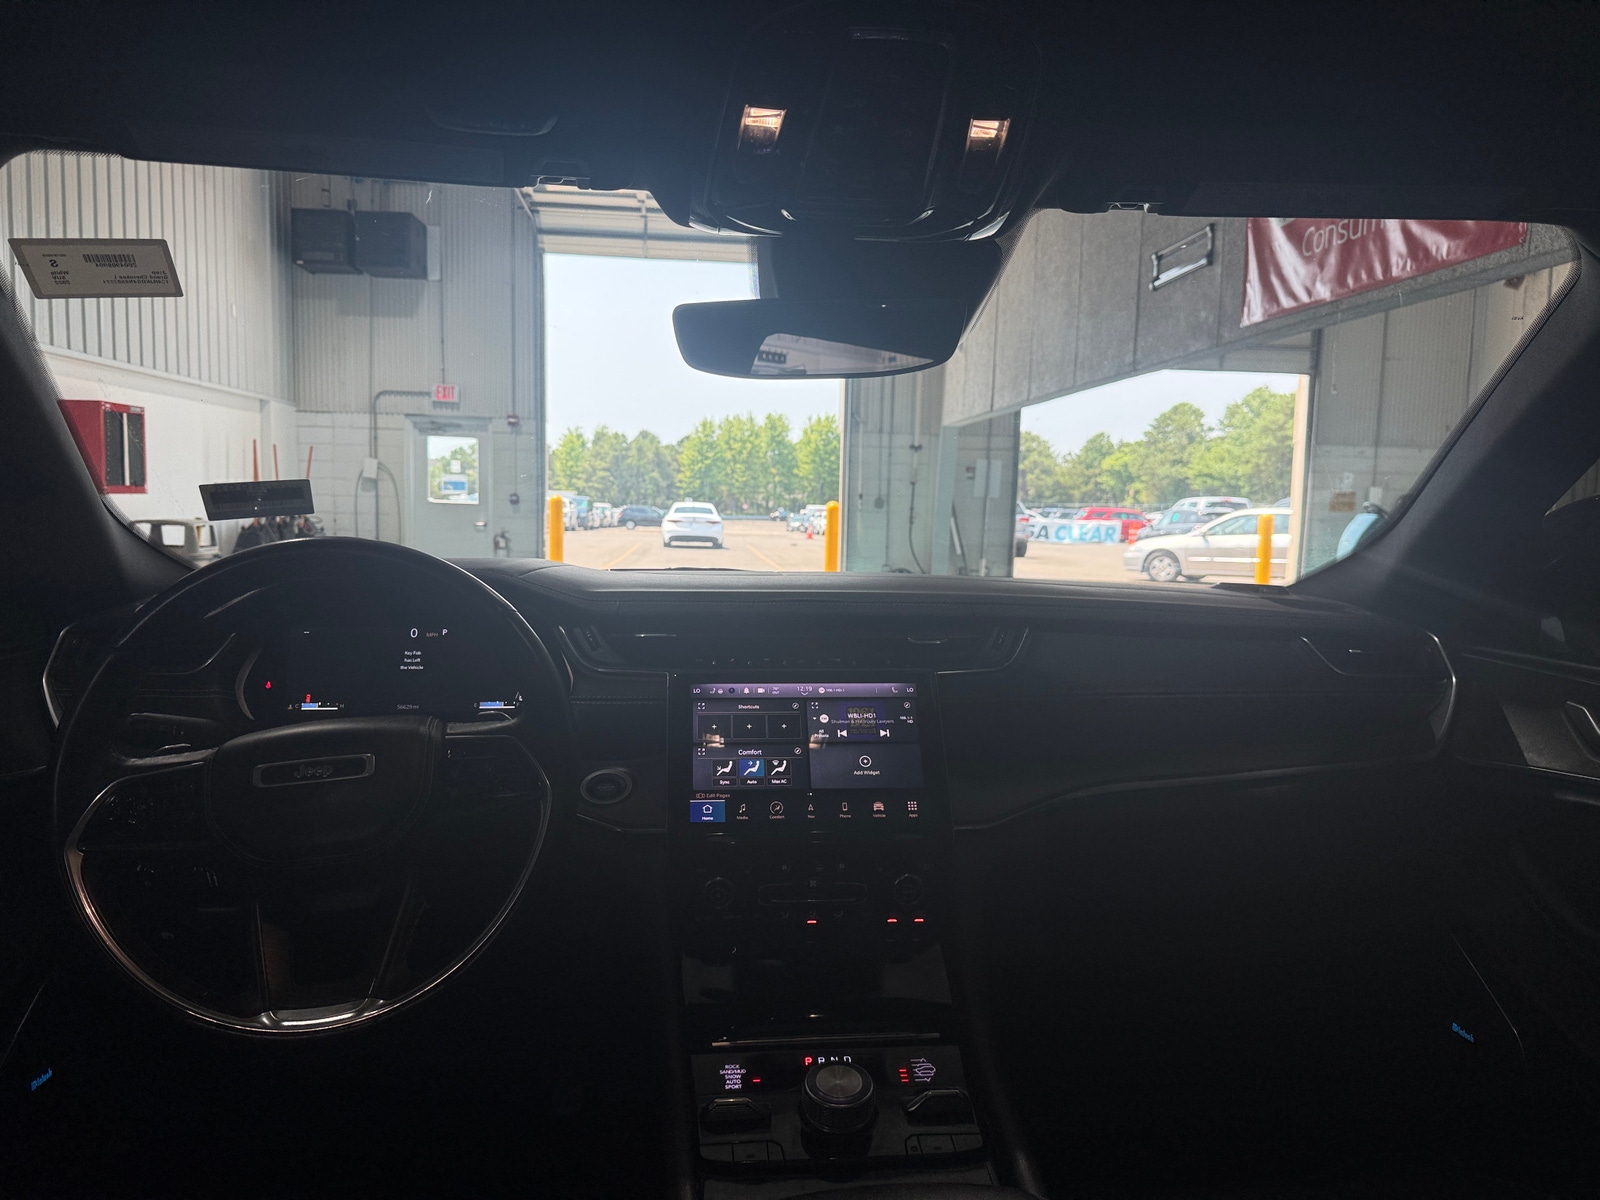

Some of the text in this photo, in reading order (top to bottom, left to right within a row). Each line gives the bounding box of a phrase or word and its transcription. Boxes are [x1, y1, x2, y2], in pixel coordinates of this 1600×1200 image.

[435, 385, 455, 400] EXIT
[1055, 524, 1117, 541] CLEAR
[410, 627, 419, 638] 0
[442, 628, 448, 636] P
[293, 764, 334, 778] Jeep
[804, 1056, 813, 1066] P
